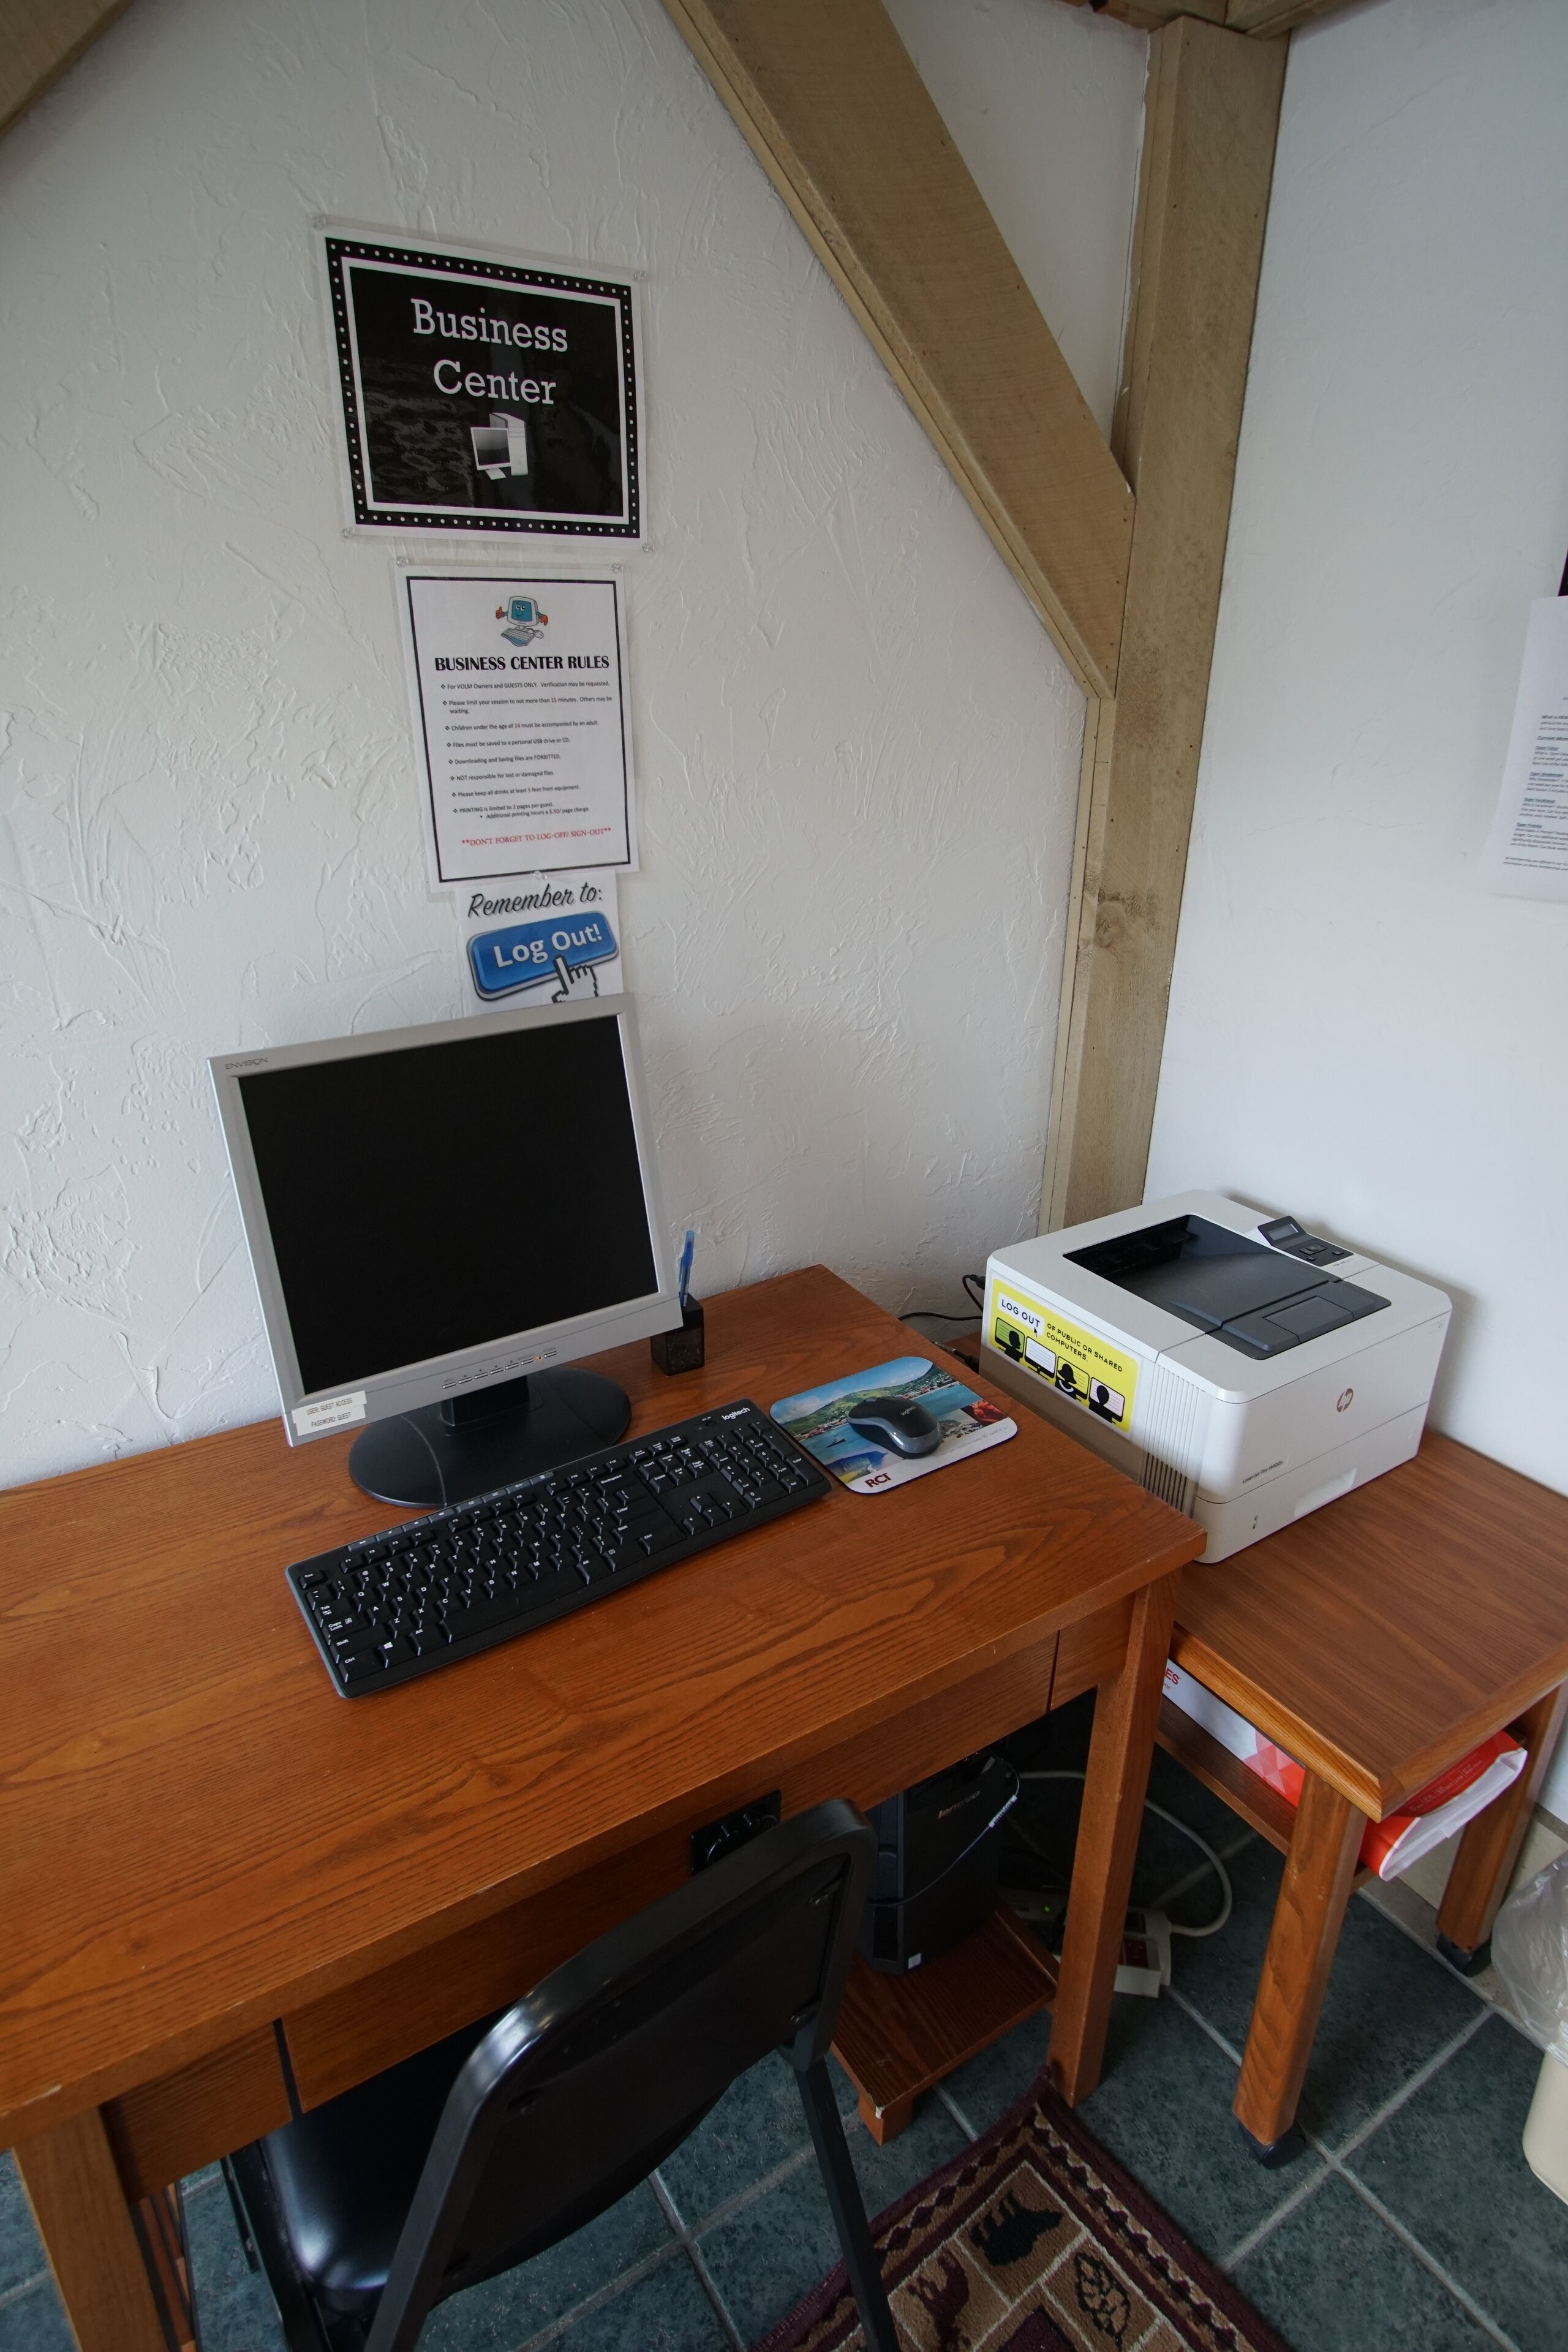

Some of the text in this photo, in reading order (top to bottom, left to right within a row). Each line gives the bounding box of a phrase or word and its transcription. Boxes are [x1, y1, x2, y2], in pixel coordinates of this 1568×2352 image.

[410, 298, 568, 352] Business
[434, 359, 556, 405] Center
[435, 655, 609, 671] BUSINESS CENTER RULES
[467, 882, 603, 918] Remember to:
[493, 923, 603, 968] Log Out!
[1001, 1299, 1040, 1327] LOG OUT
[1046, 1332, 1088, 1362] COMPUTERS.
[1057, 1329, 1080, 1347] PUBLIC
[1083, 1345, 1092, 1354] OR
[1094, 1351, 1123, 1372] SHARED
[320, 1402, 334, 1411] GUEST
[336, 1398, 353, 1407] ACCESS
[722, 1407, 750, 1420] logitech
[311, 1412, 351, 1428] PASSWORD: GUEST
[864, 1472, 892, 1488] RCI
[1243, 1472, 1260, 1483] LaserJet
